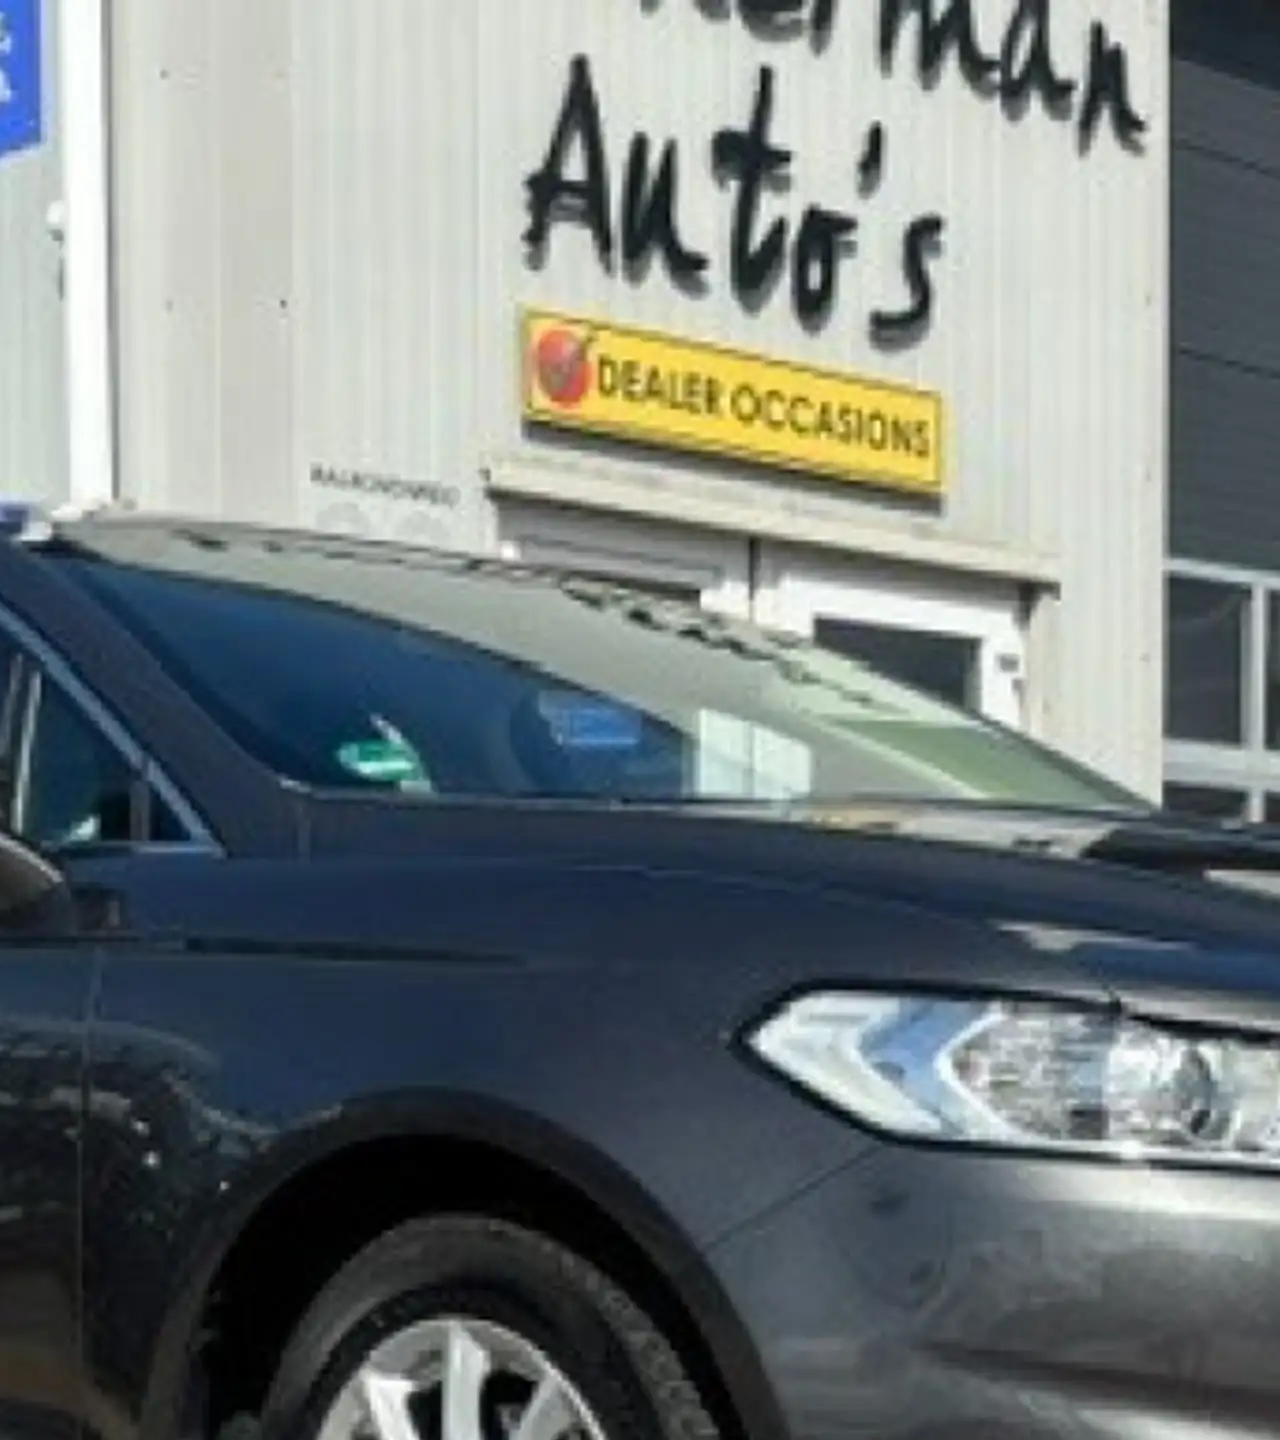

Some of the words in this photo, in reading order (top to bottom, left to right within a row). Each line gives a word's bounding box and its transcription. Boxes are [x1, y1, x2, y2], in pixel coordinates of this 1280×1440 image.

[522, 54, 945, 346] Auto's
[597, 353, 722, 415] DEALER
[729, 382, 931, 459] OCCASIONS
